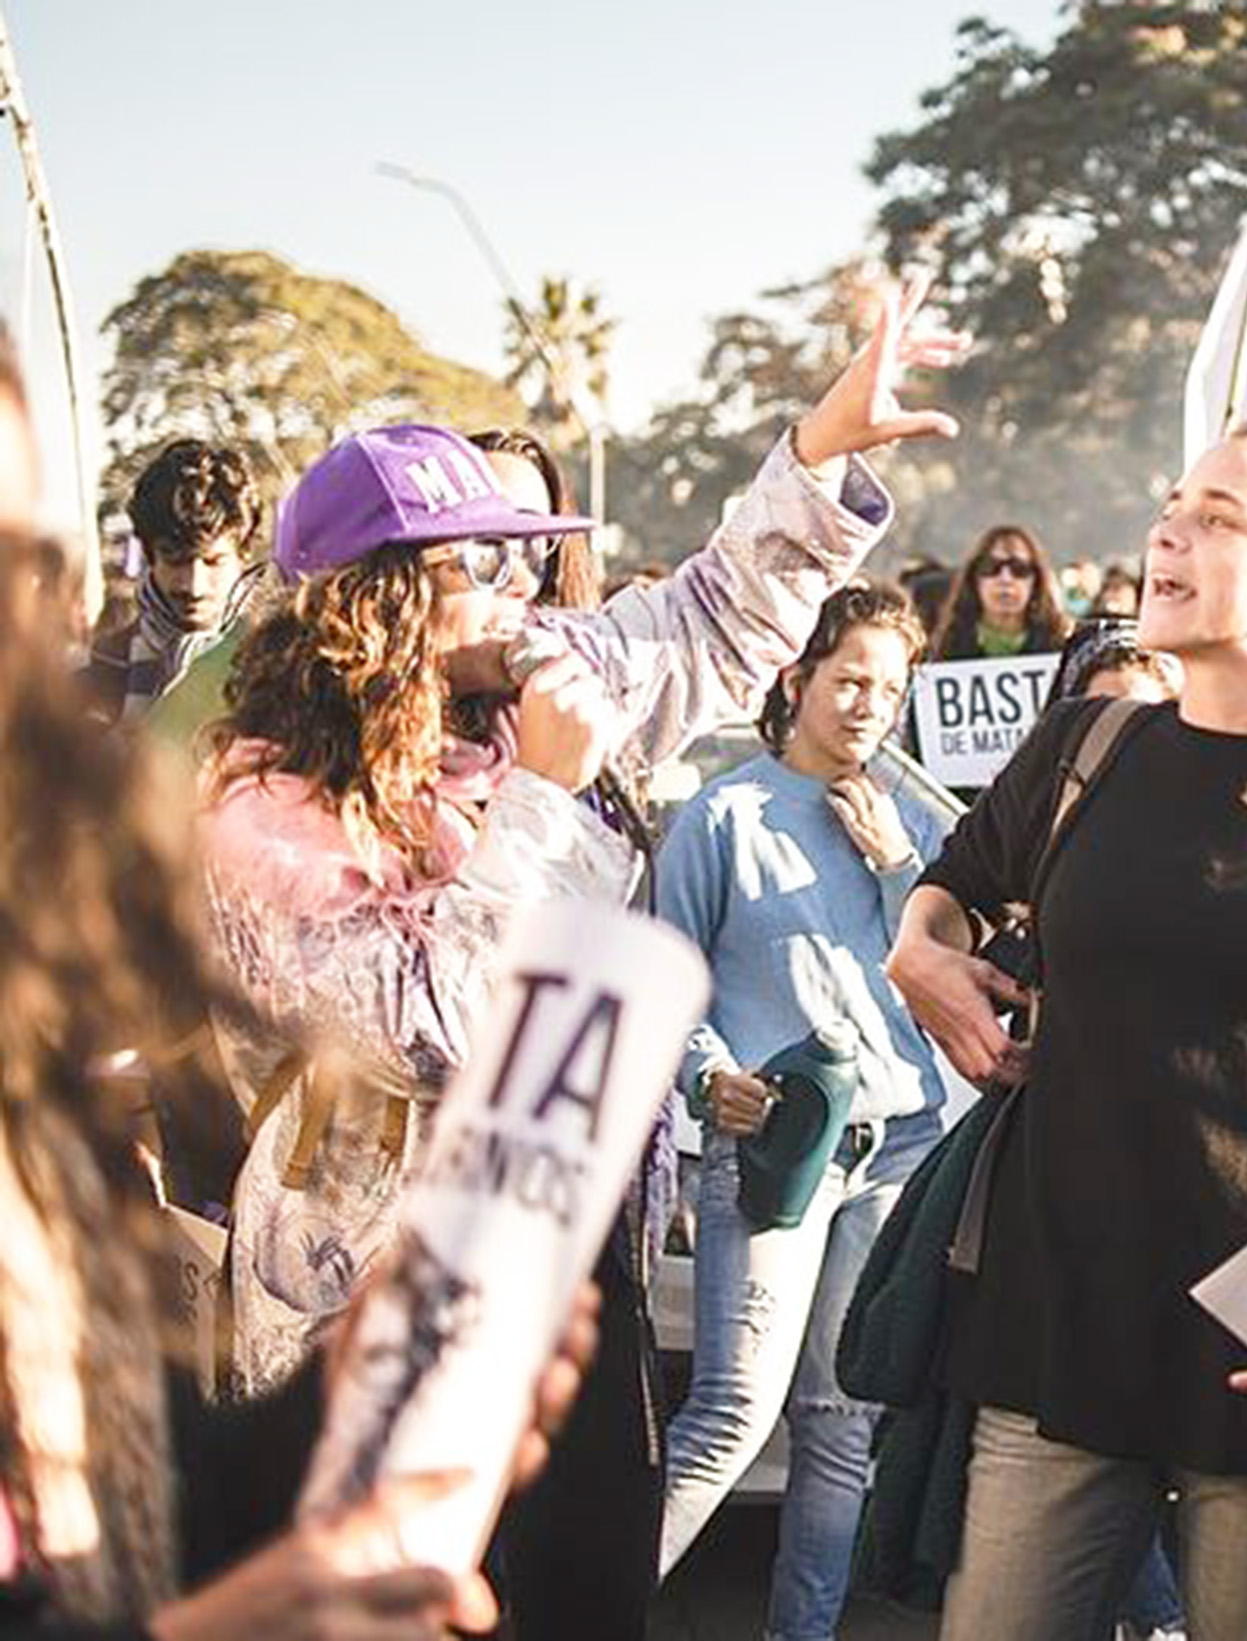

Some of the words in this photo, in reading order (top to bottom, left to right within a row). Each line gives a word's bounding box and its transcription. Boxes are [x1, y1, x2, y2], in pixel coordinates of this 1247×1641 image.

[935, 669, 1046, 728] BAST
[940, 730, 968, 755] DE
[487, 972, 626, 1143] TA
